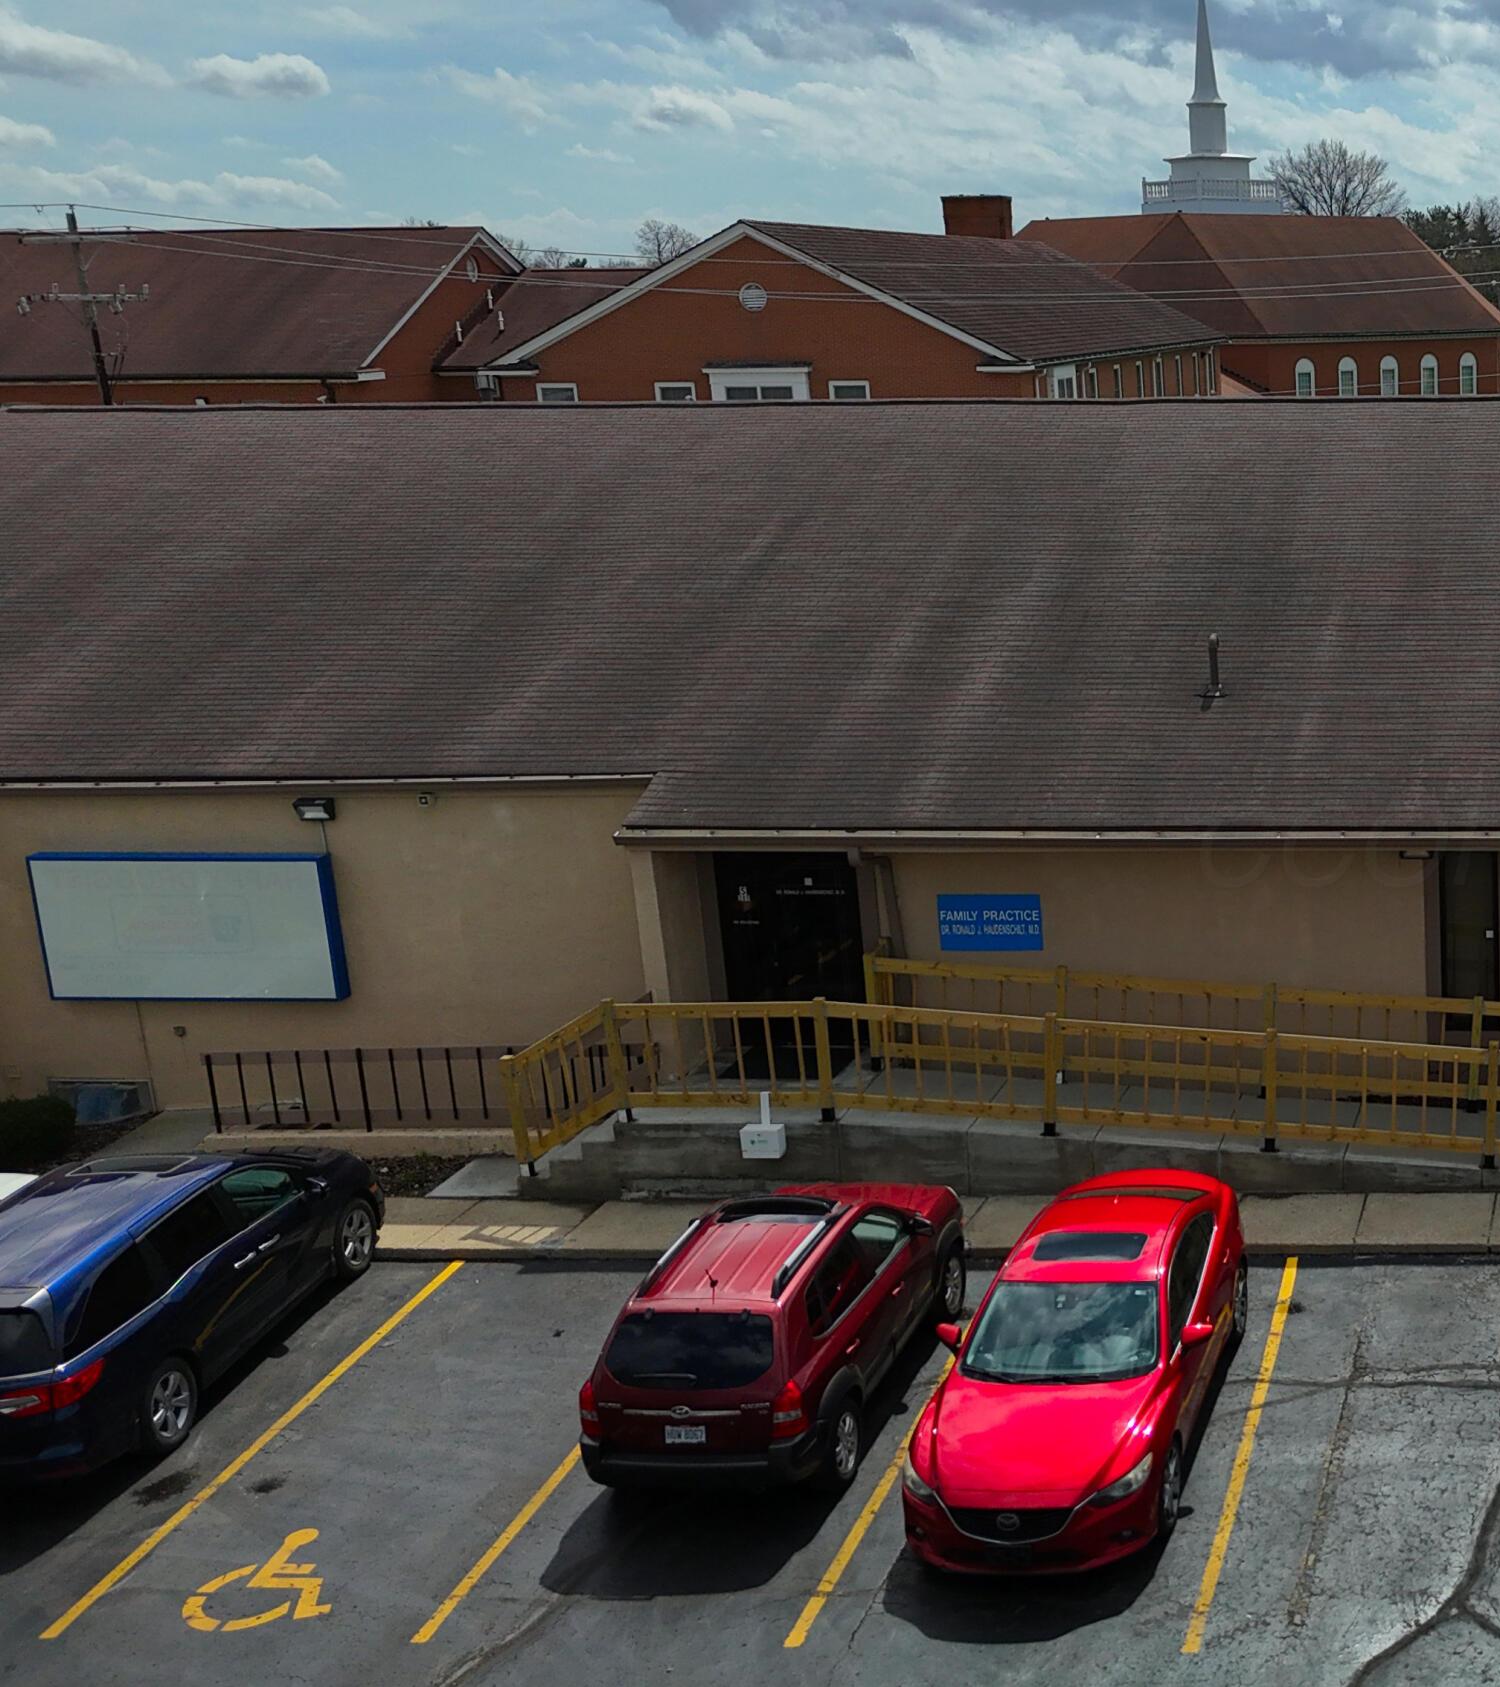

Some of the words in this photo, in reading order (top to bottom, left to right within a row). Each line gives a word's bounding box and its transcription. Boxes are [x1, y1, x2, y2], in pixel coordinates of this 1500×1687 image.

[940, 910, 978, 921] FAMILY
[983, 910, 1039, 921] PRACTICE
[952, 924, 976, 935] RONALD
